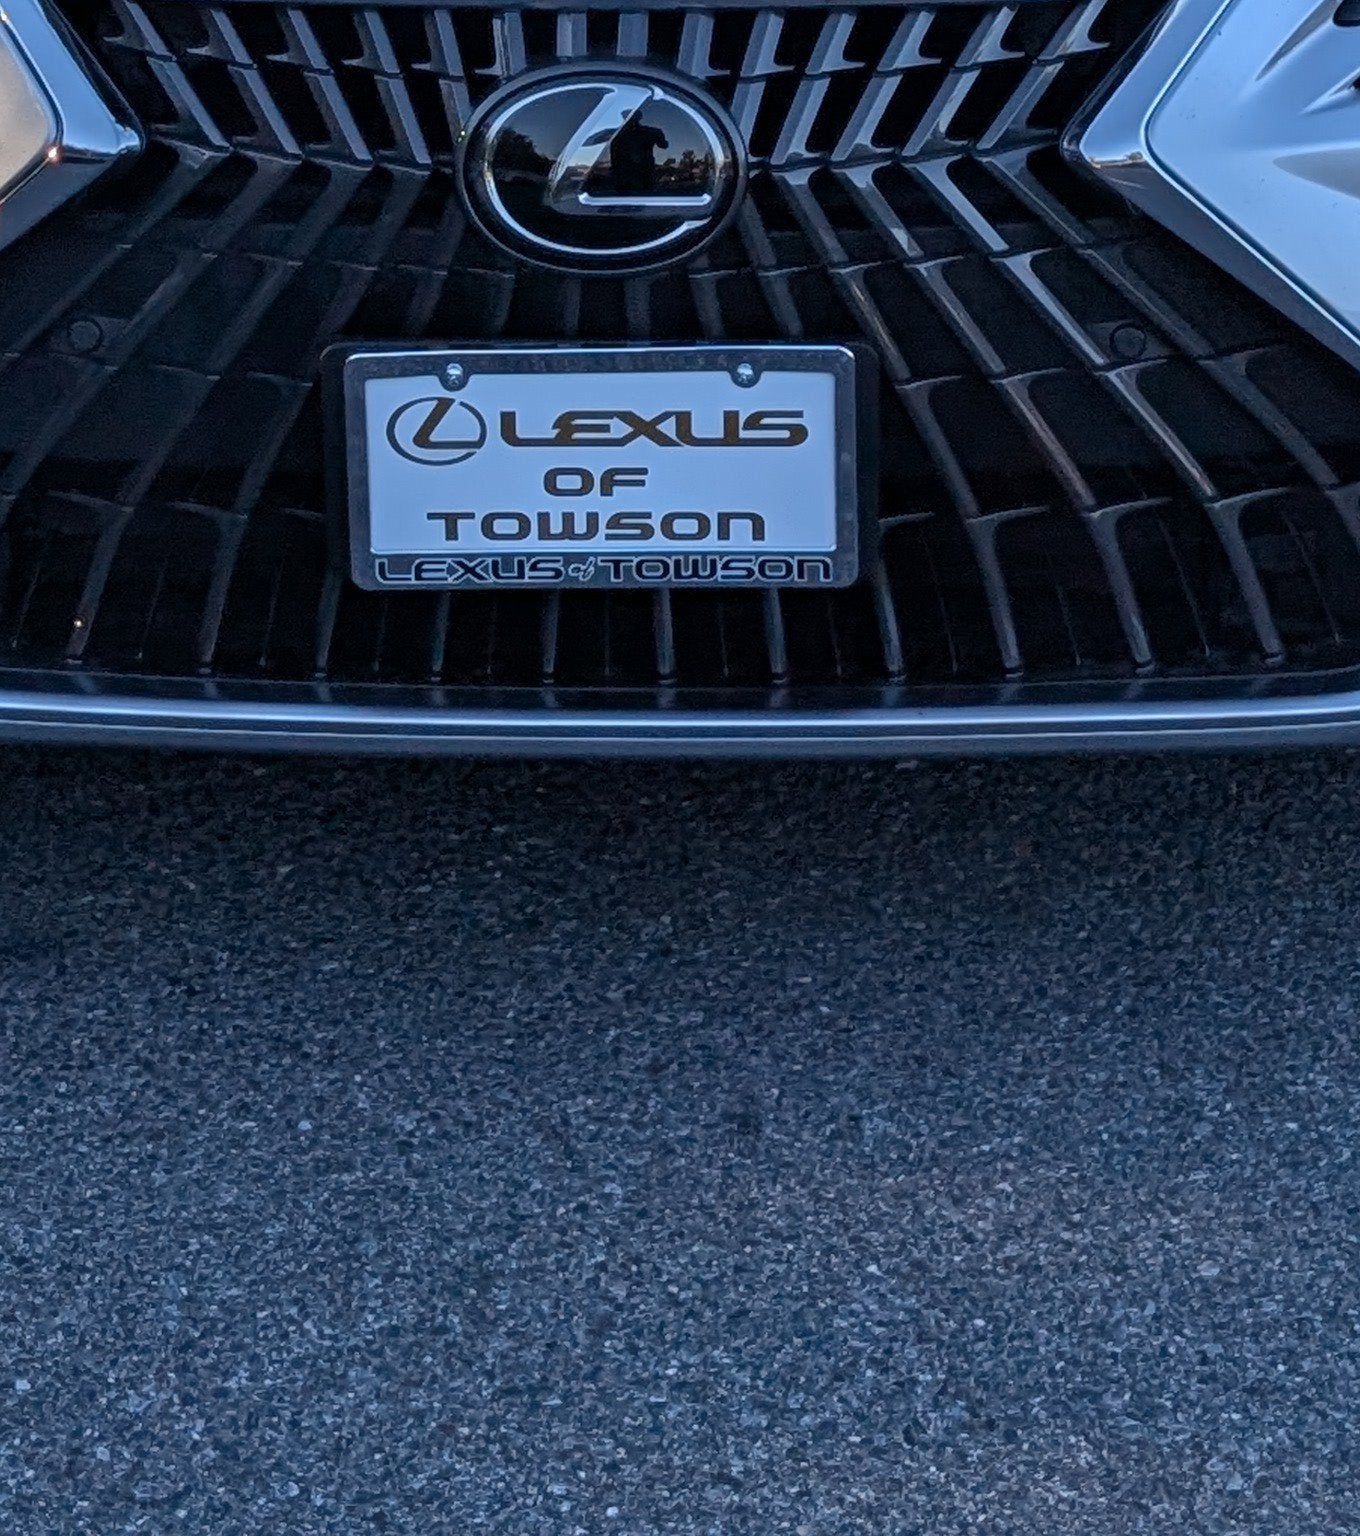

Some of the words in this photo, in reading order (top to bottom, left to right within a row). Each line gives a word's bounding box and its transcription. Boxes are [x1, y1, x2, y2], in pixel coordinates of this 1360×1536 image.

[499, 409, 809, 448] LEXUS
[543, 466, 649, 497] OF
[426, 511, 766, 542] TOWSON
[374, 556, 565, 584] LEXUS
[567, 555, 596, 583] of
[597, 555, 833, 583] TOWSON
